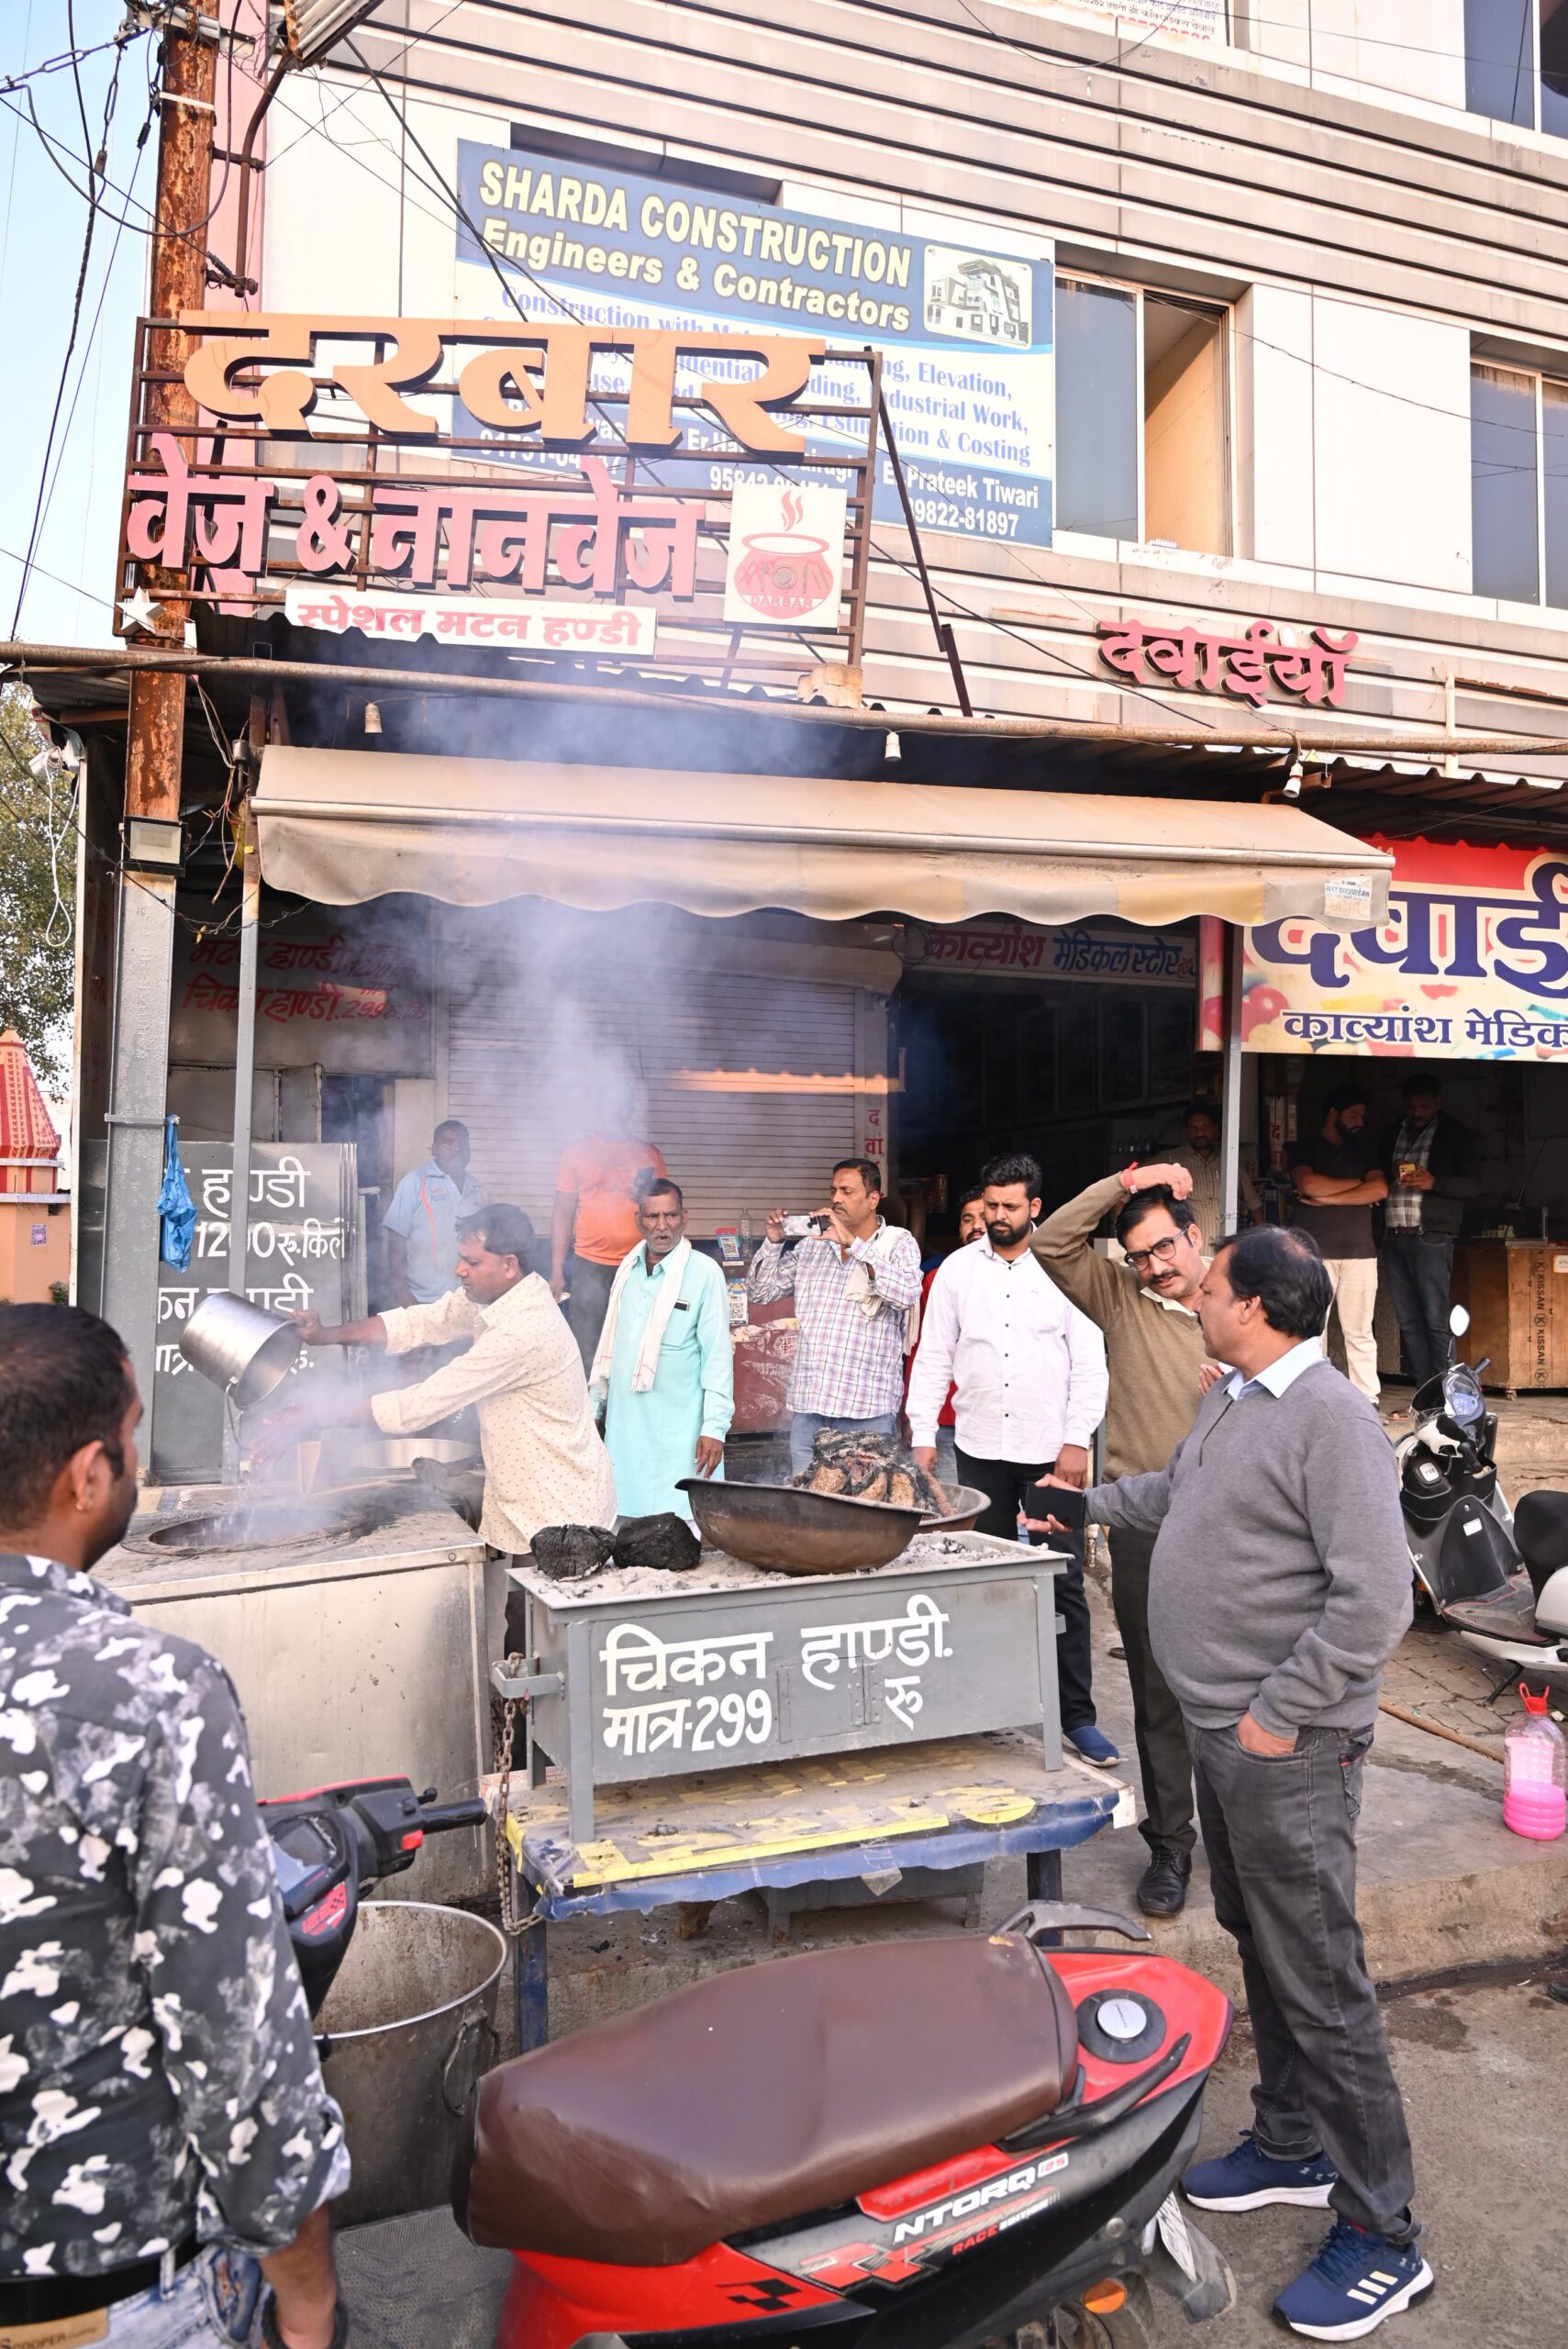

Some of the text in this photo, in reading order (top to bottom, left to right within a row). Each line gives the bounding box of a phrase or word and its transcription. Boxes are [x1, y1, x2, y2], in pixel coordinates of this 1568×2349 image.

[480, 161, 911, 288] SHARDA CONSTRUCTION
[481, 217, 910, 331] Engineers & Contractors
[502, 286, 650, 330] Construction
[178, 309, 827, 455] दरबार
[918, 362, 1012, 401] Elevation,
[973, 403, 1029, 435] Work,
[936, 429, 951, 450] &
[958, 431, 1030, 468] Costing
[984, 476, 1039, 508] Tiwari
[127, 432, 706, 601] वेज & नानवेज
[298, 595, 642, 647] स्पेशल मटन हण्डी
[751, 596, 814, 609] DARBAR
[928, 924, 1046, 969] काव्यांश
[1052, 928, 1133, 974] मेडिकल
[1131, 935, 1183, 977] स्टोर
[1282, 1005, 1453, 1044] काव्यांश
[1536, 1274, 1546, 1310] KISSAN
[1536, 1329, 1546, 1365] KISSAN
[599, 1623, 774, 1697] चिकन
[884, 1675, 923, 1731] रु
[894, 2166, 1037, 2245] NTORQ
[952, 2223, 998, 2255] RACE
